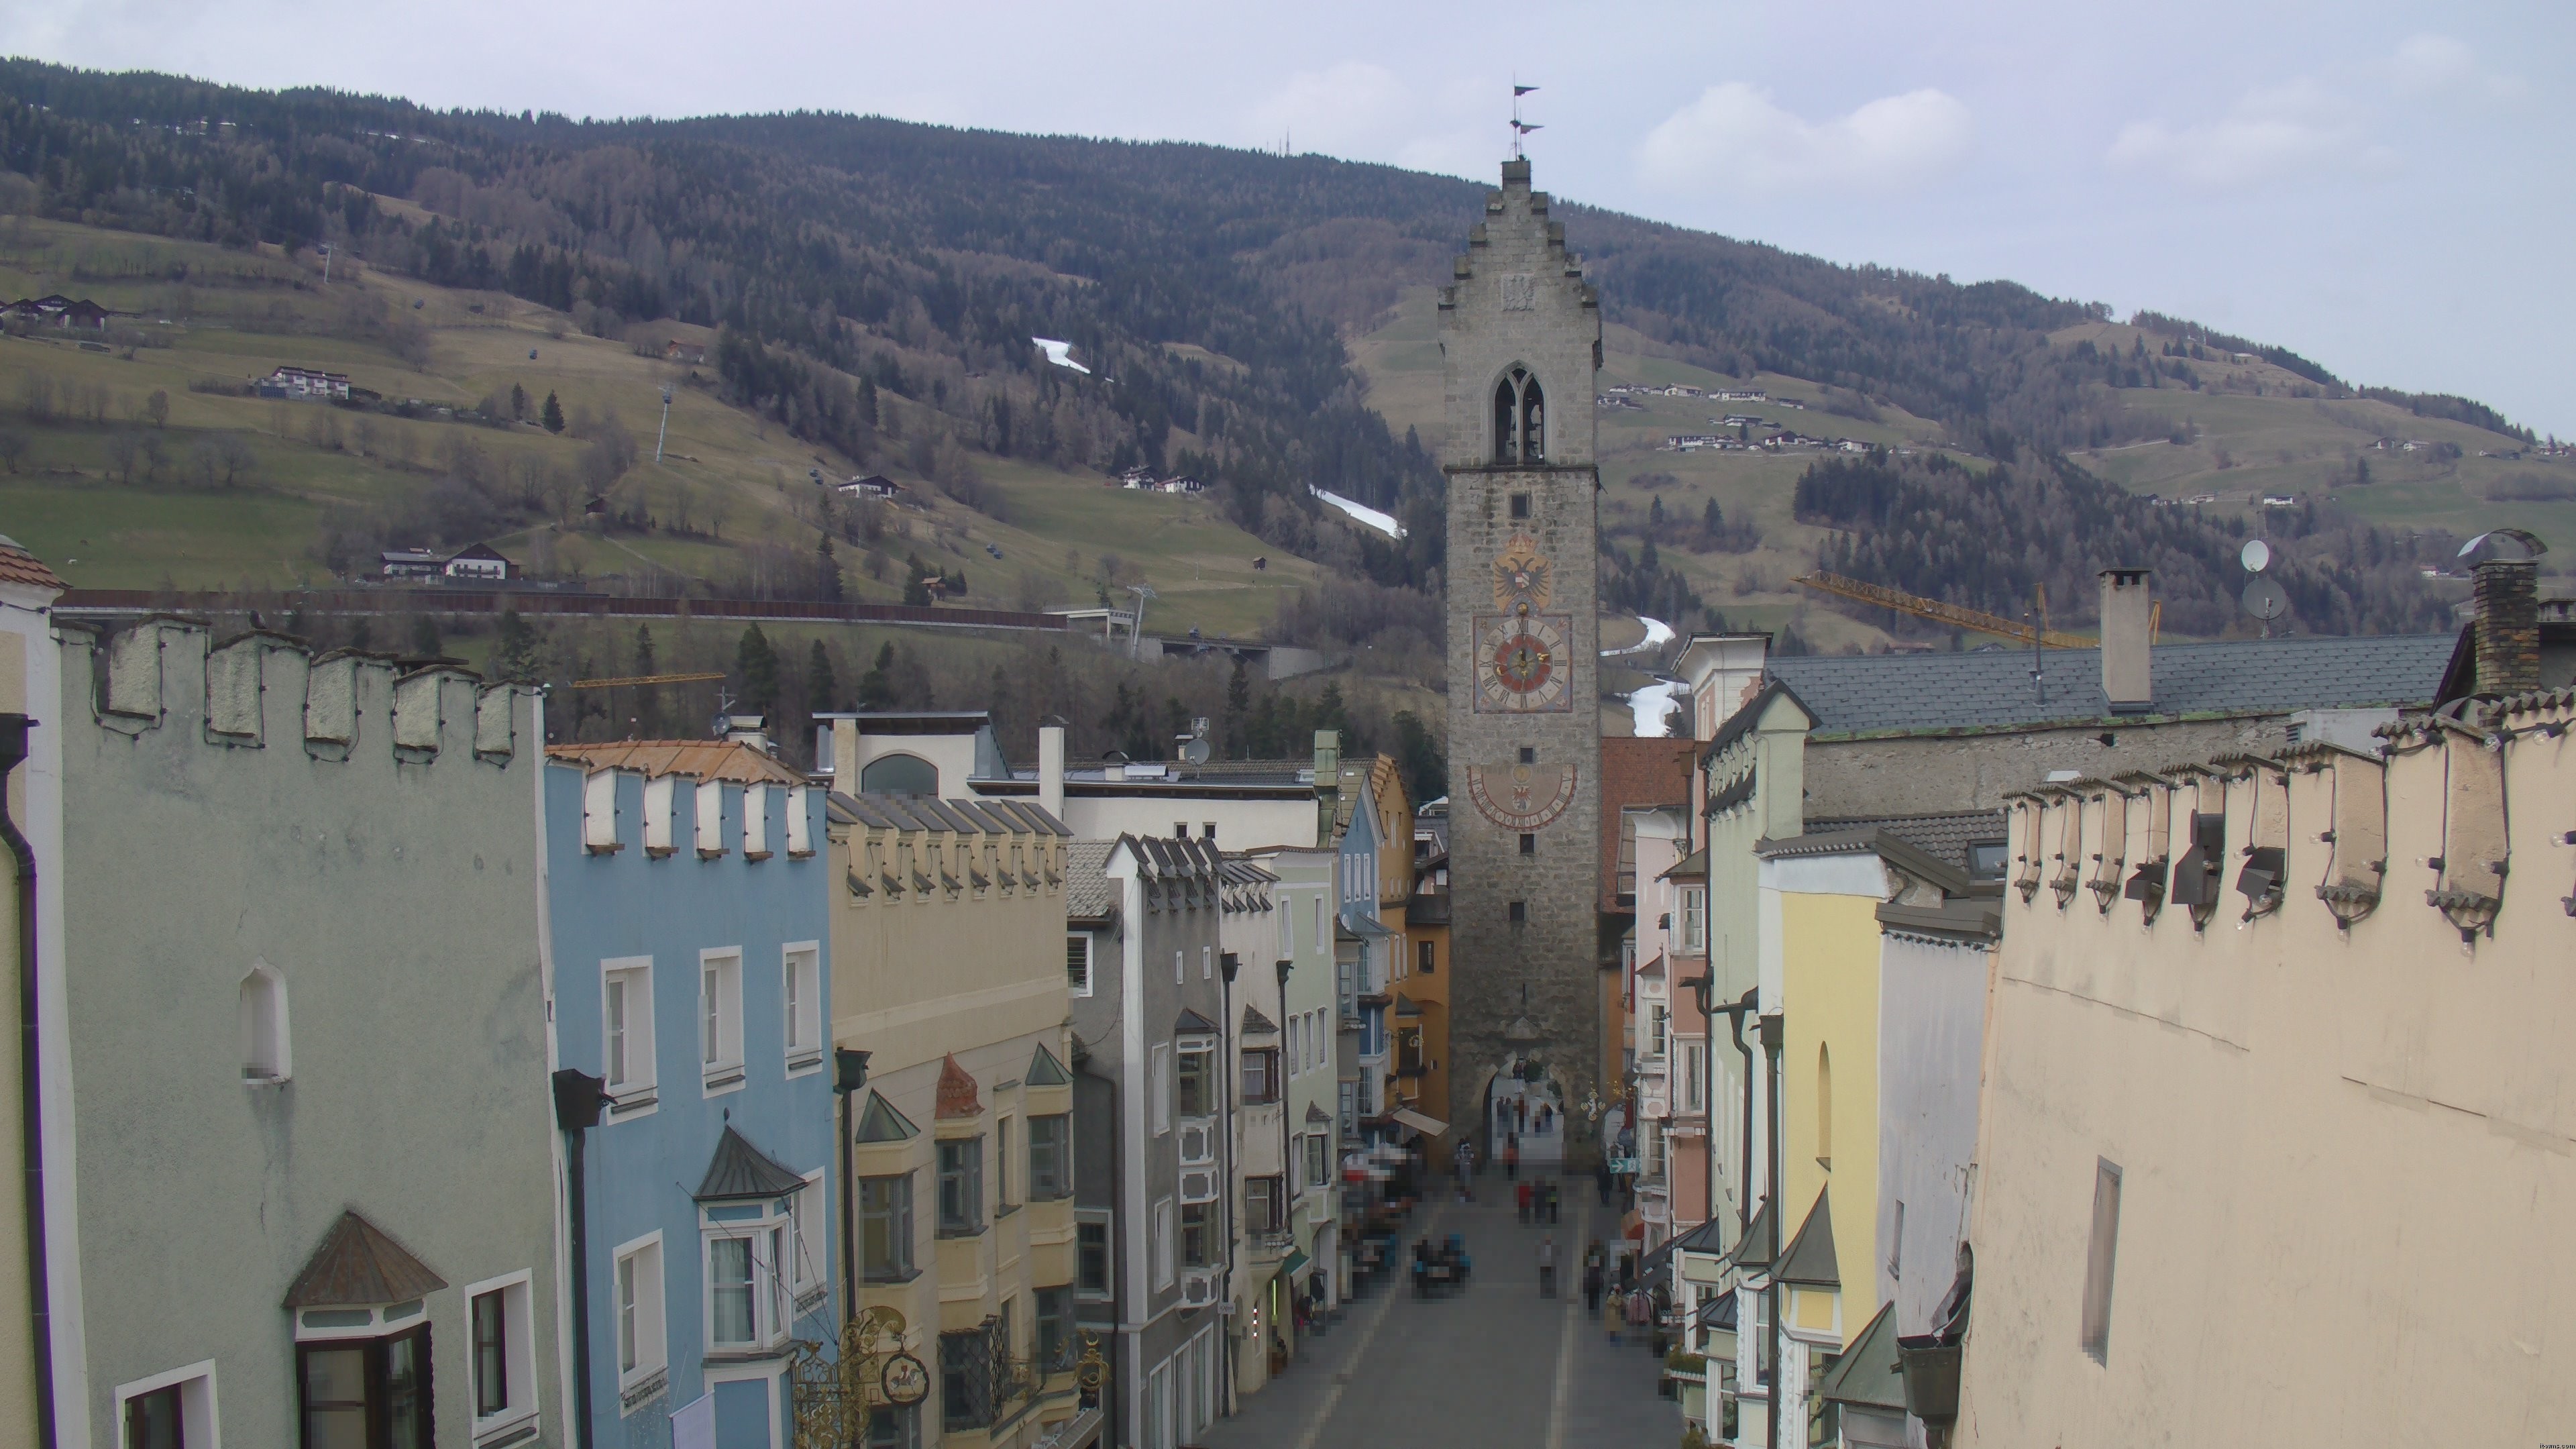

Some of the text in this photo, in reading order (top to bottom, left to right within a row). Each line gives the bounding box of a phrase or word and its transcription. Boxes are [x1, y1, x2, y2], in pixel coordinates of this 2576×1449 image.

[1538, 625, 1545, 637] I
[1549, 639, 1562, 649] II
[1550, 676, 1562, 689] IV
[1520, 694, 1527, 708] VI
[1538, 690, 1548, 703] V
